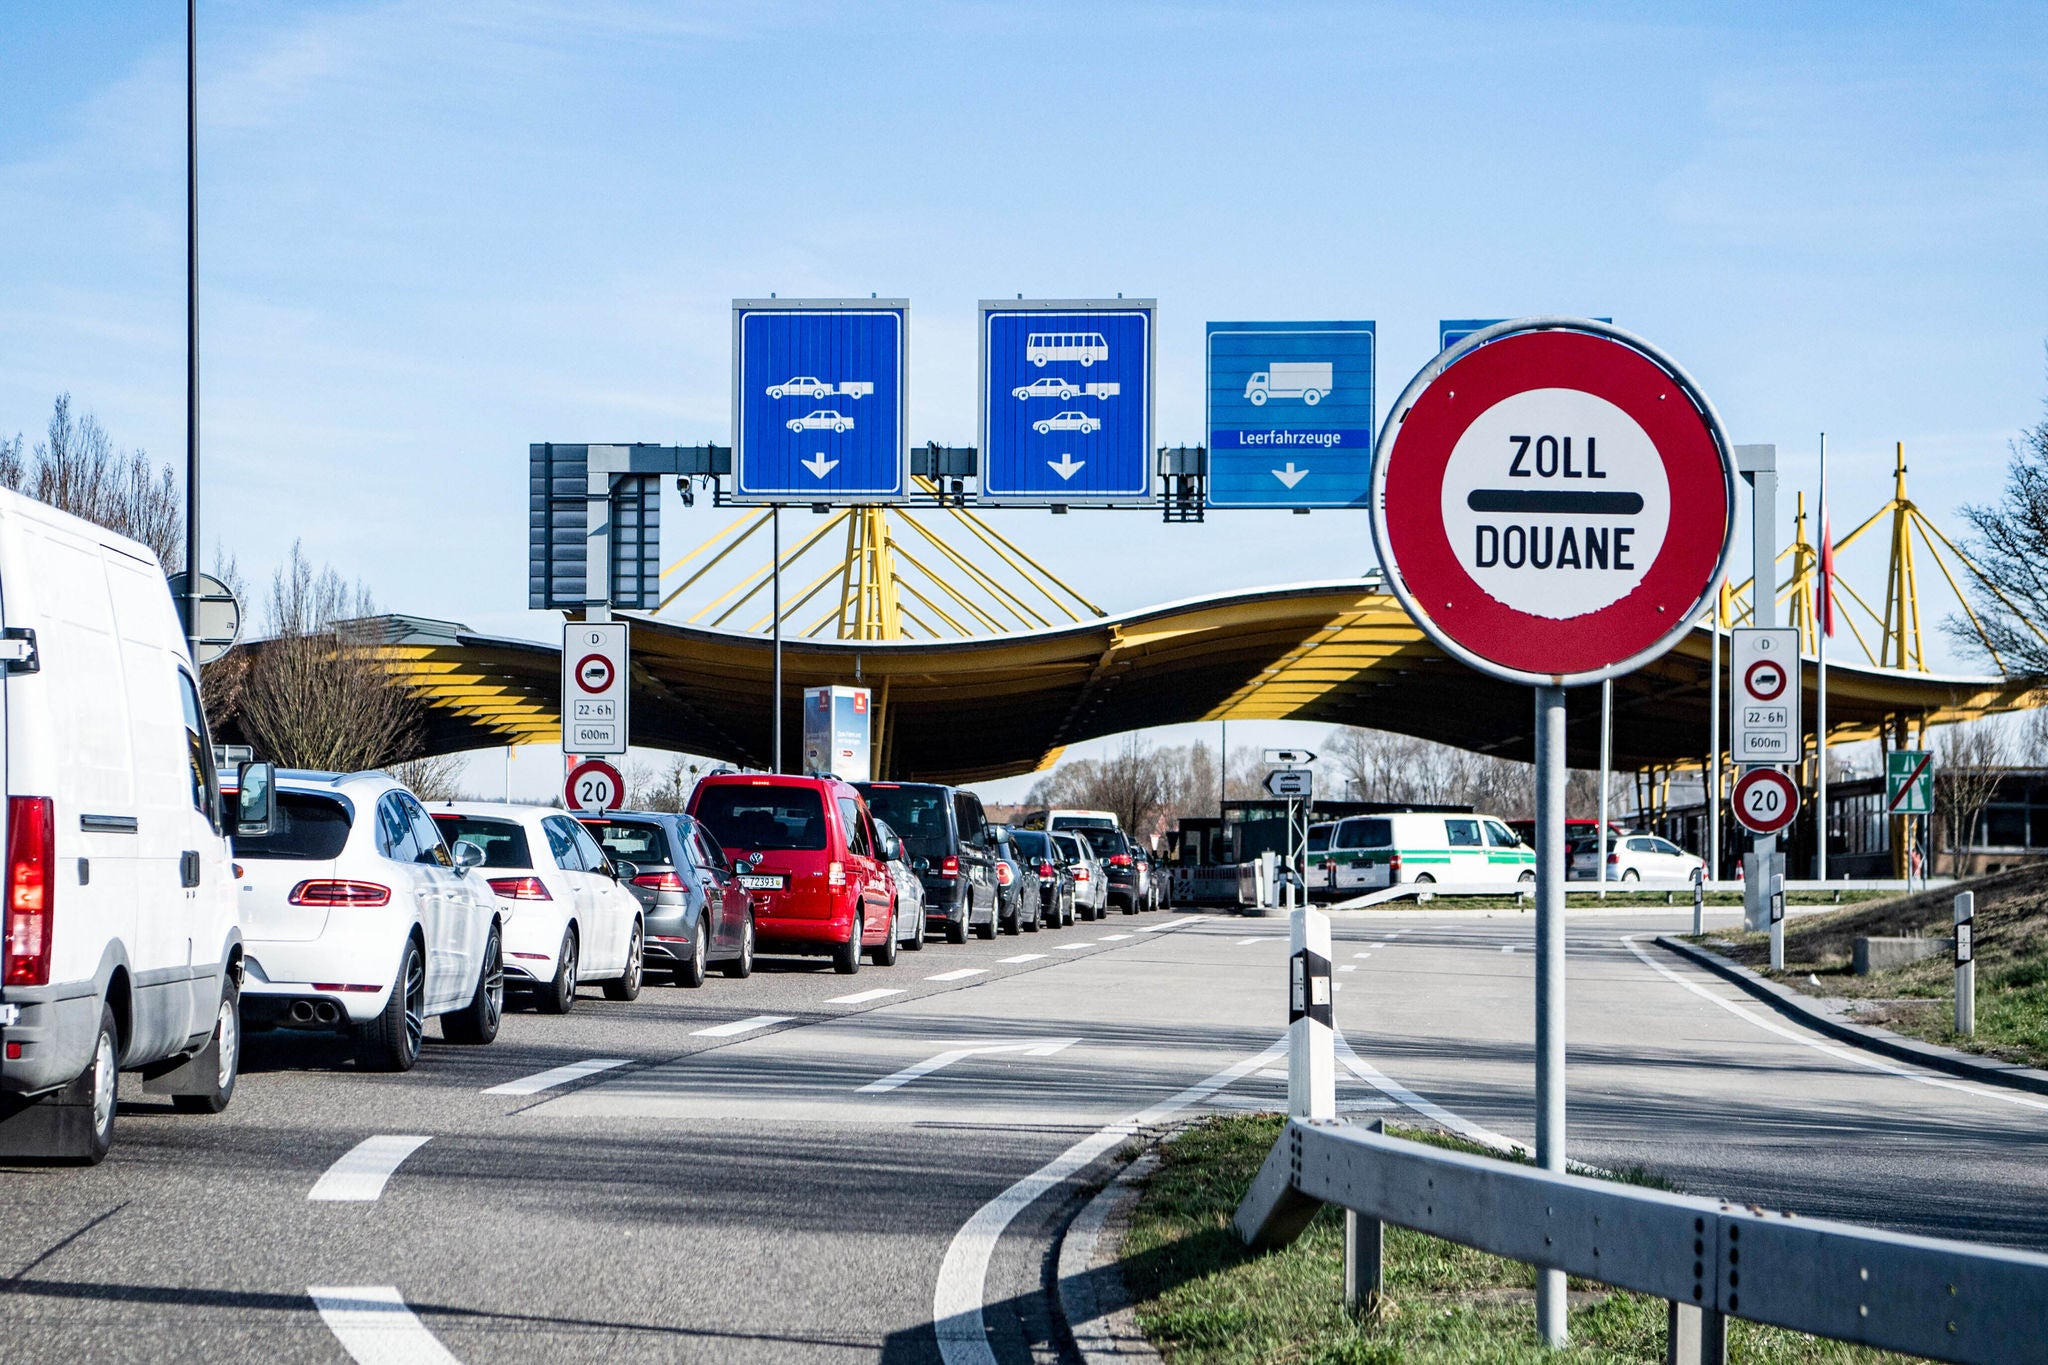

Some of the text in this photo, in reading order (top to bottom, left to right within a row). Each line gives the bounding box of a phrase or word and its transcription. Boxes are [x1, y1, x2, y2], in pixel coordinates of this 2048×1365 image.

[1239, 430, 1341, 448] Leerfahrzeuge
[1509, 434, 1607, 479] ZOLL
[1475, 525, 1635, 570] DOUANE
[591, 633, 600, 644] D
[1761, 639, 1770, 650] D
[578, 704, 590, 715] 22
[597, 704, 604, 715] 6
[605, 704, 612, 715] h
[1748, 712, 1761, 723] 22
[1768, 712, 1775, 723] 6
[1777, 711, 1783, 722] h
[580, 729, 609, 740] 600m
[1750, 737, 1781, 748] 600m
[582, 781, 607, 802] 20
[1751, 790, 1778, 811] 20
